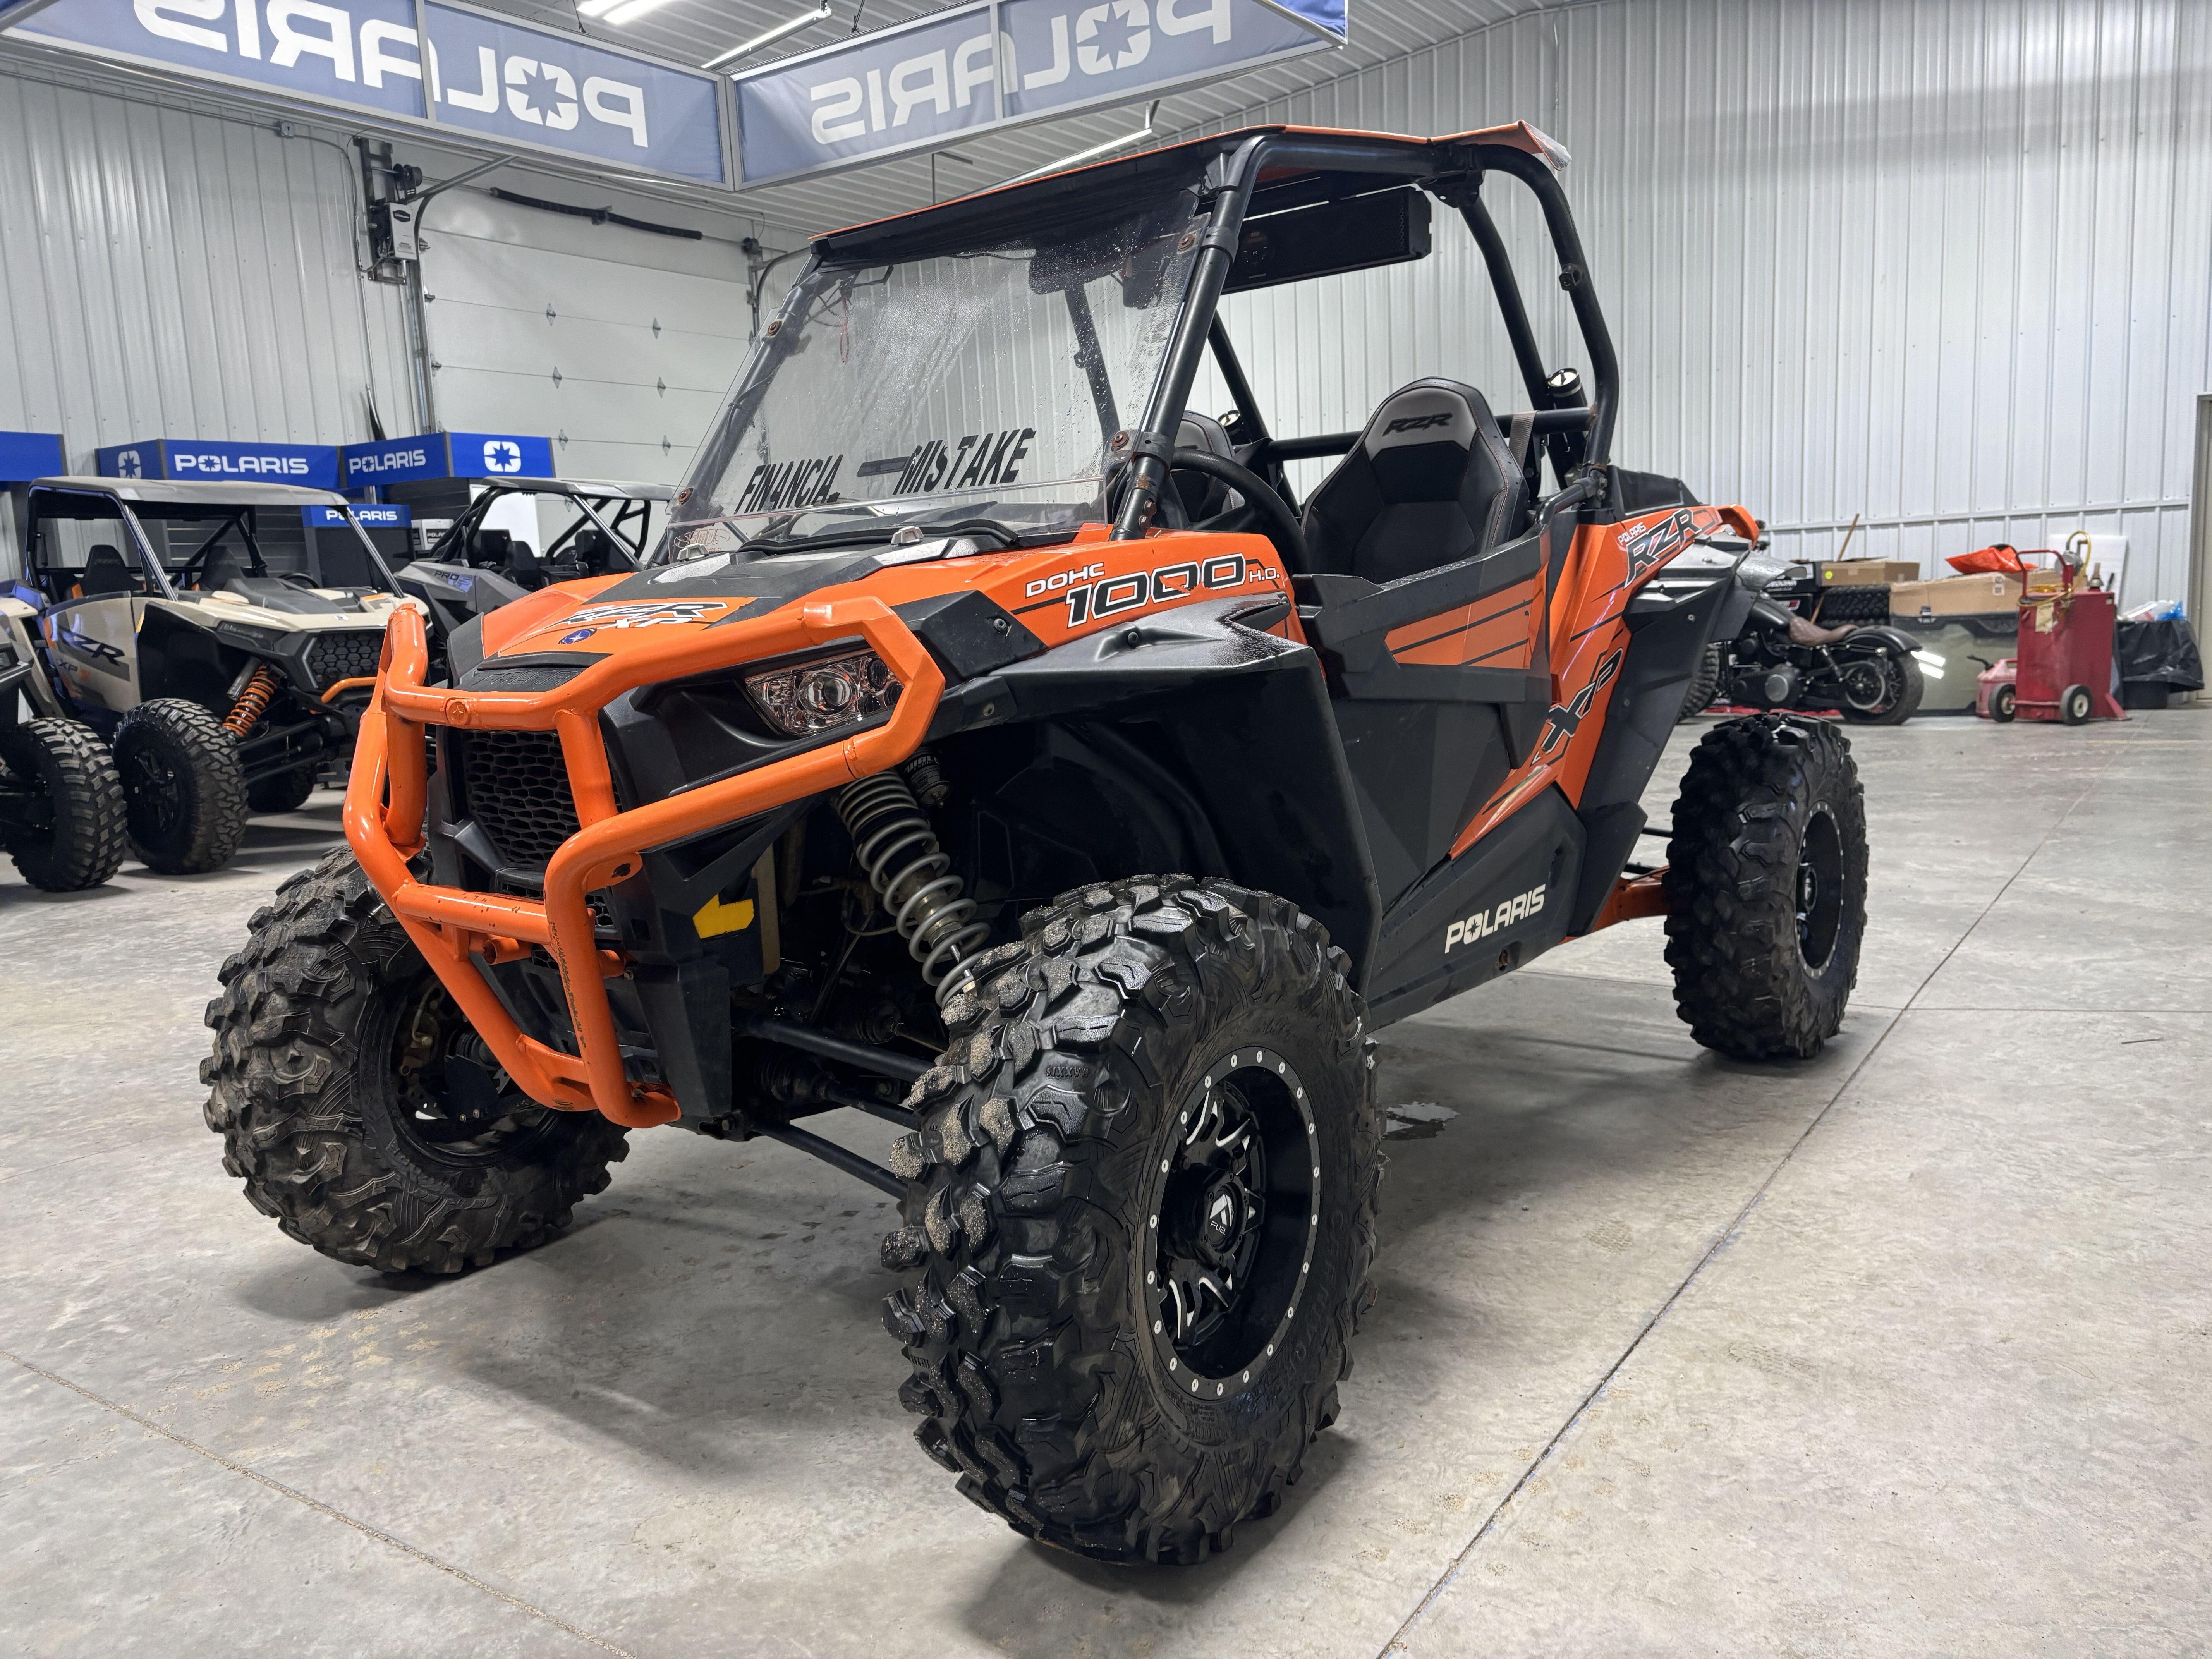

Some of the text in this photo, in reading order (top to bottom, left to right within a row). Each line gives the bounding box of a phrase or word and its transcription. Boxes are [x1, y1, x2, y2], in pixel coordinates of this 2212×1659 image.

[1382, 412, 1453, 436] RZR
[174, 454, 309, 474] POLARIS
[349, 449, 426, 474] POLARIS
[734, 428, 1037, 515] FINANCIA MISTAKE
[1617, 522, 1647, 546] POLARIS
[1623, 508, 1702, 590] RZR
[1026, 562, 1105, 598] DOHC
[1065, 553, 1246, 629] 1000
[58, 659, 78, 672] XP
[1445, 884, 1546, 954] POLARIS
[1210, 1220, 1226, 1236] FUEL
